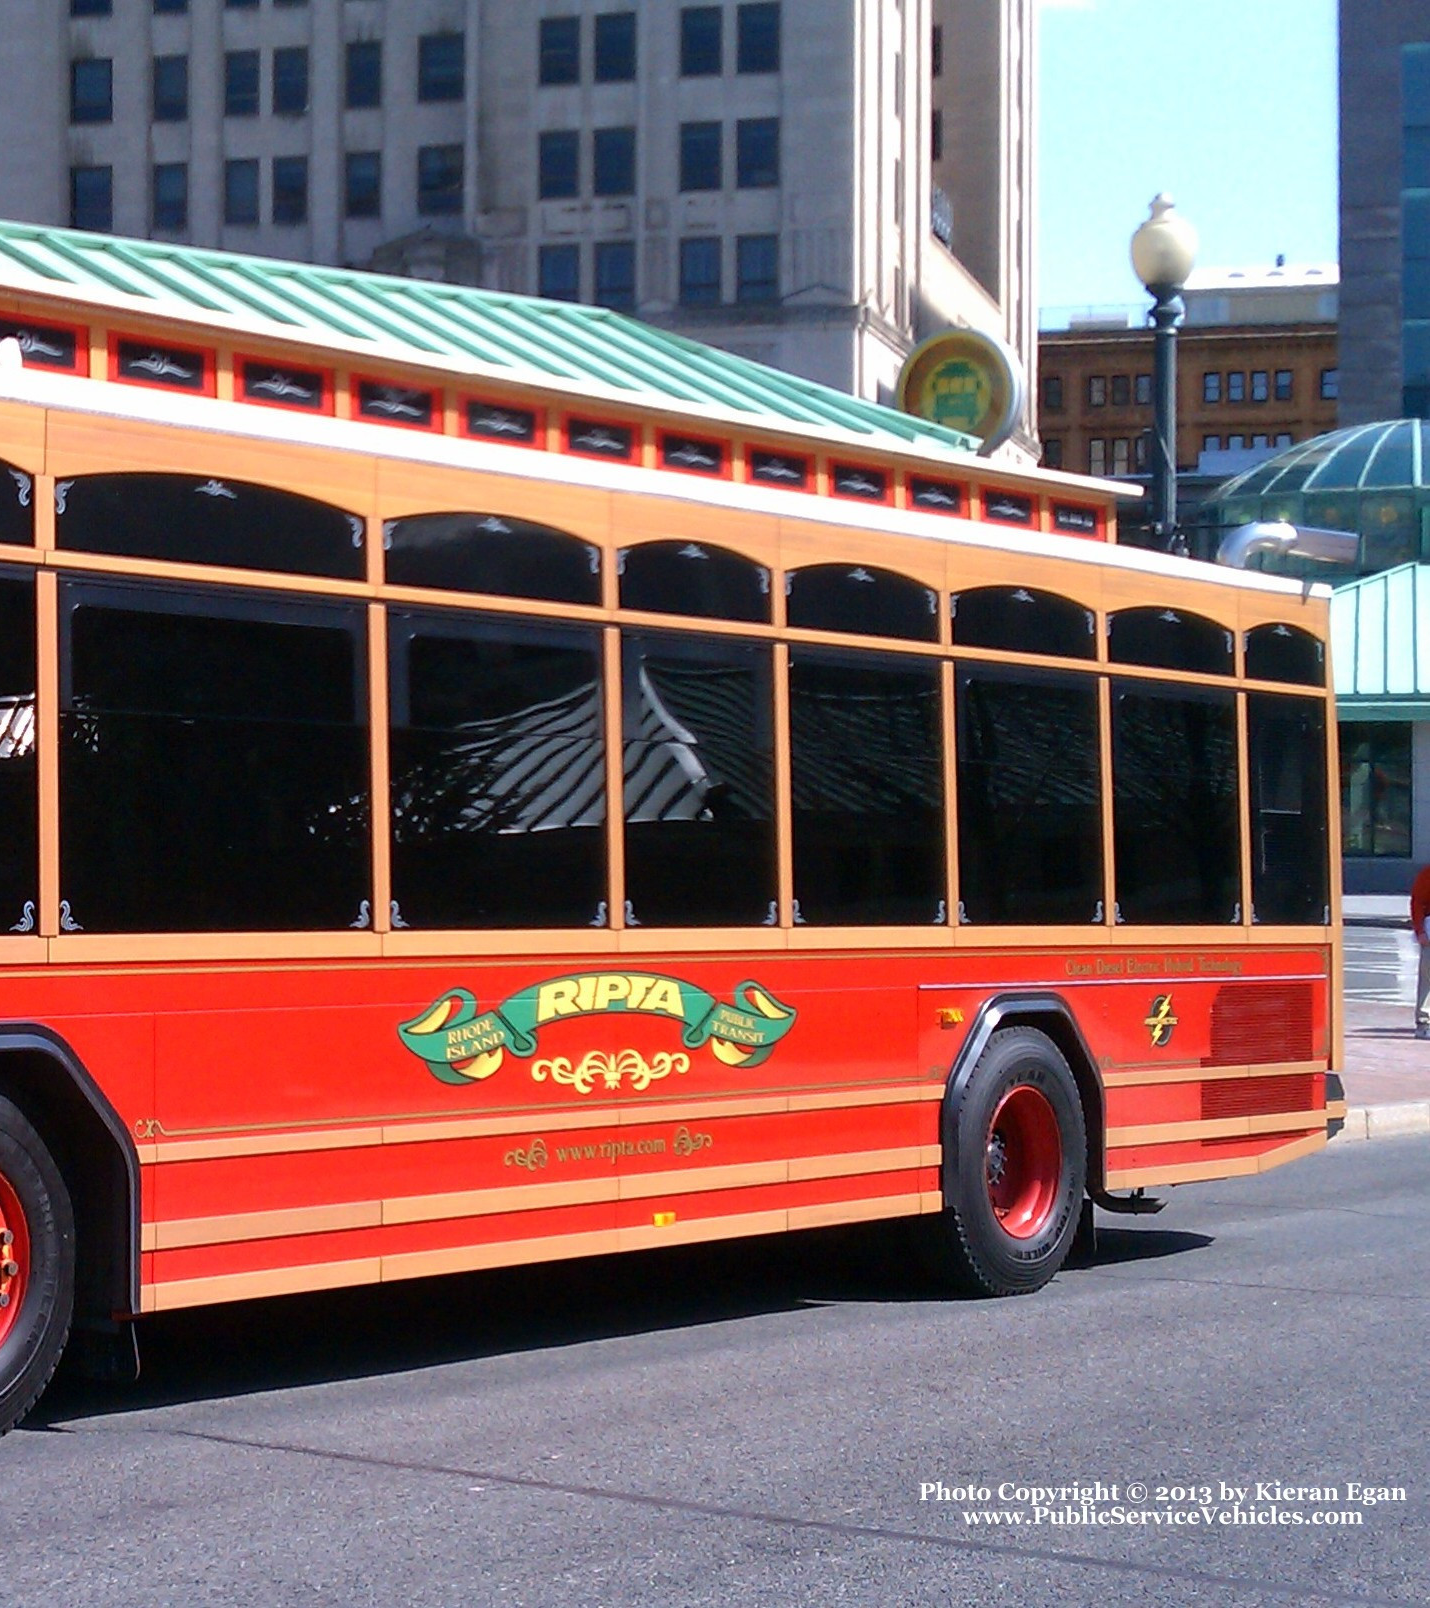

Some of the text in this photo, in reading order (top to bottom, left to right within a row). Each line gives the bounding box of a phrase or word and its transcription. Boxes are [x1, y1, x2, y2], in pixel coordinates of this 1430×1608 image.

[536, 974, 685, 1024] RIPTA
[448, 1018, 494, 1045] RHODE
[712, 1020, 765, 1043] TRANSIT
[720, 1009, 756, 1030] PUBLIC
[446, 1031, 505, 1060] ISLAND
[555, 1139, 667, 1166] www.ripta.com
